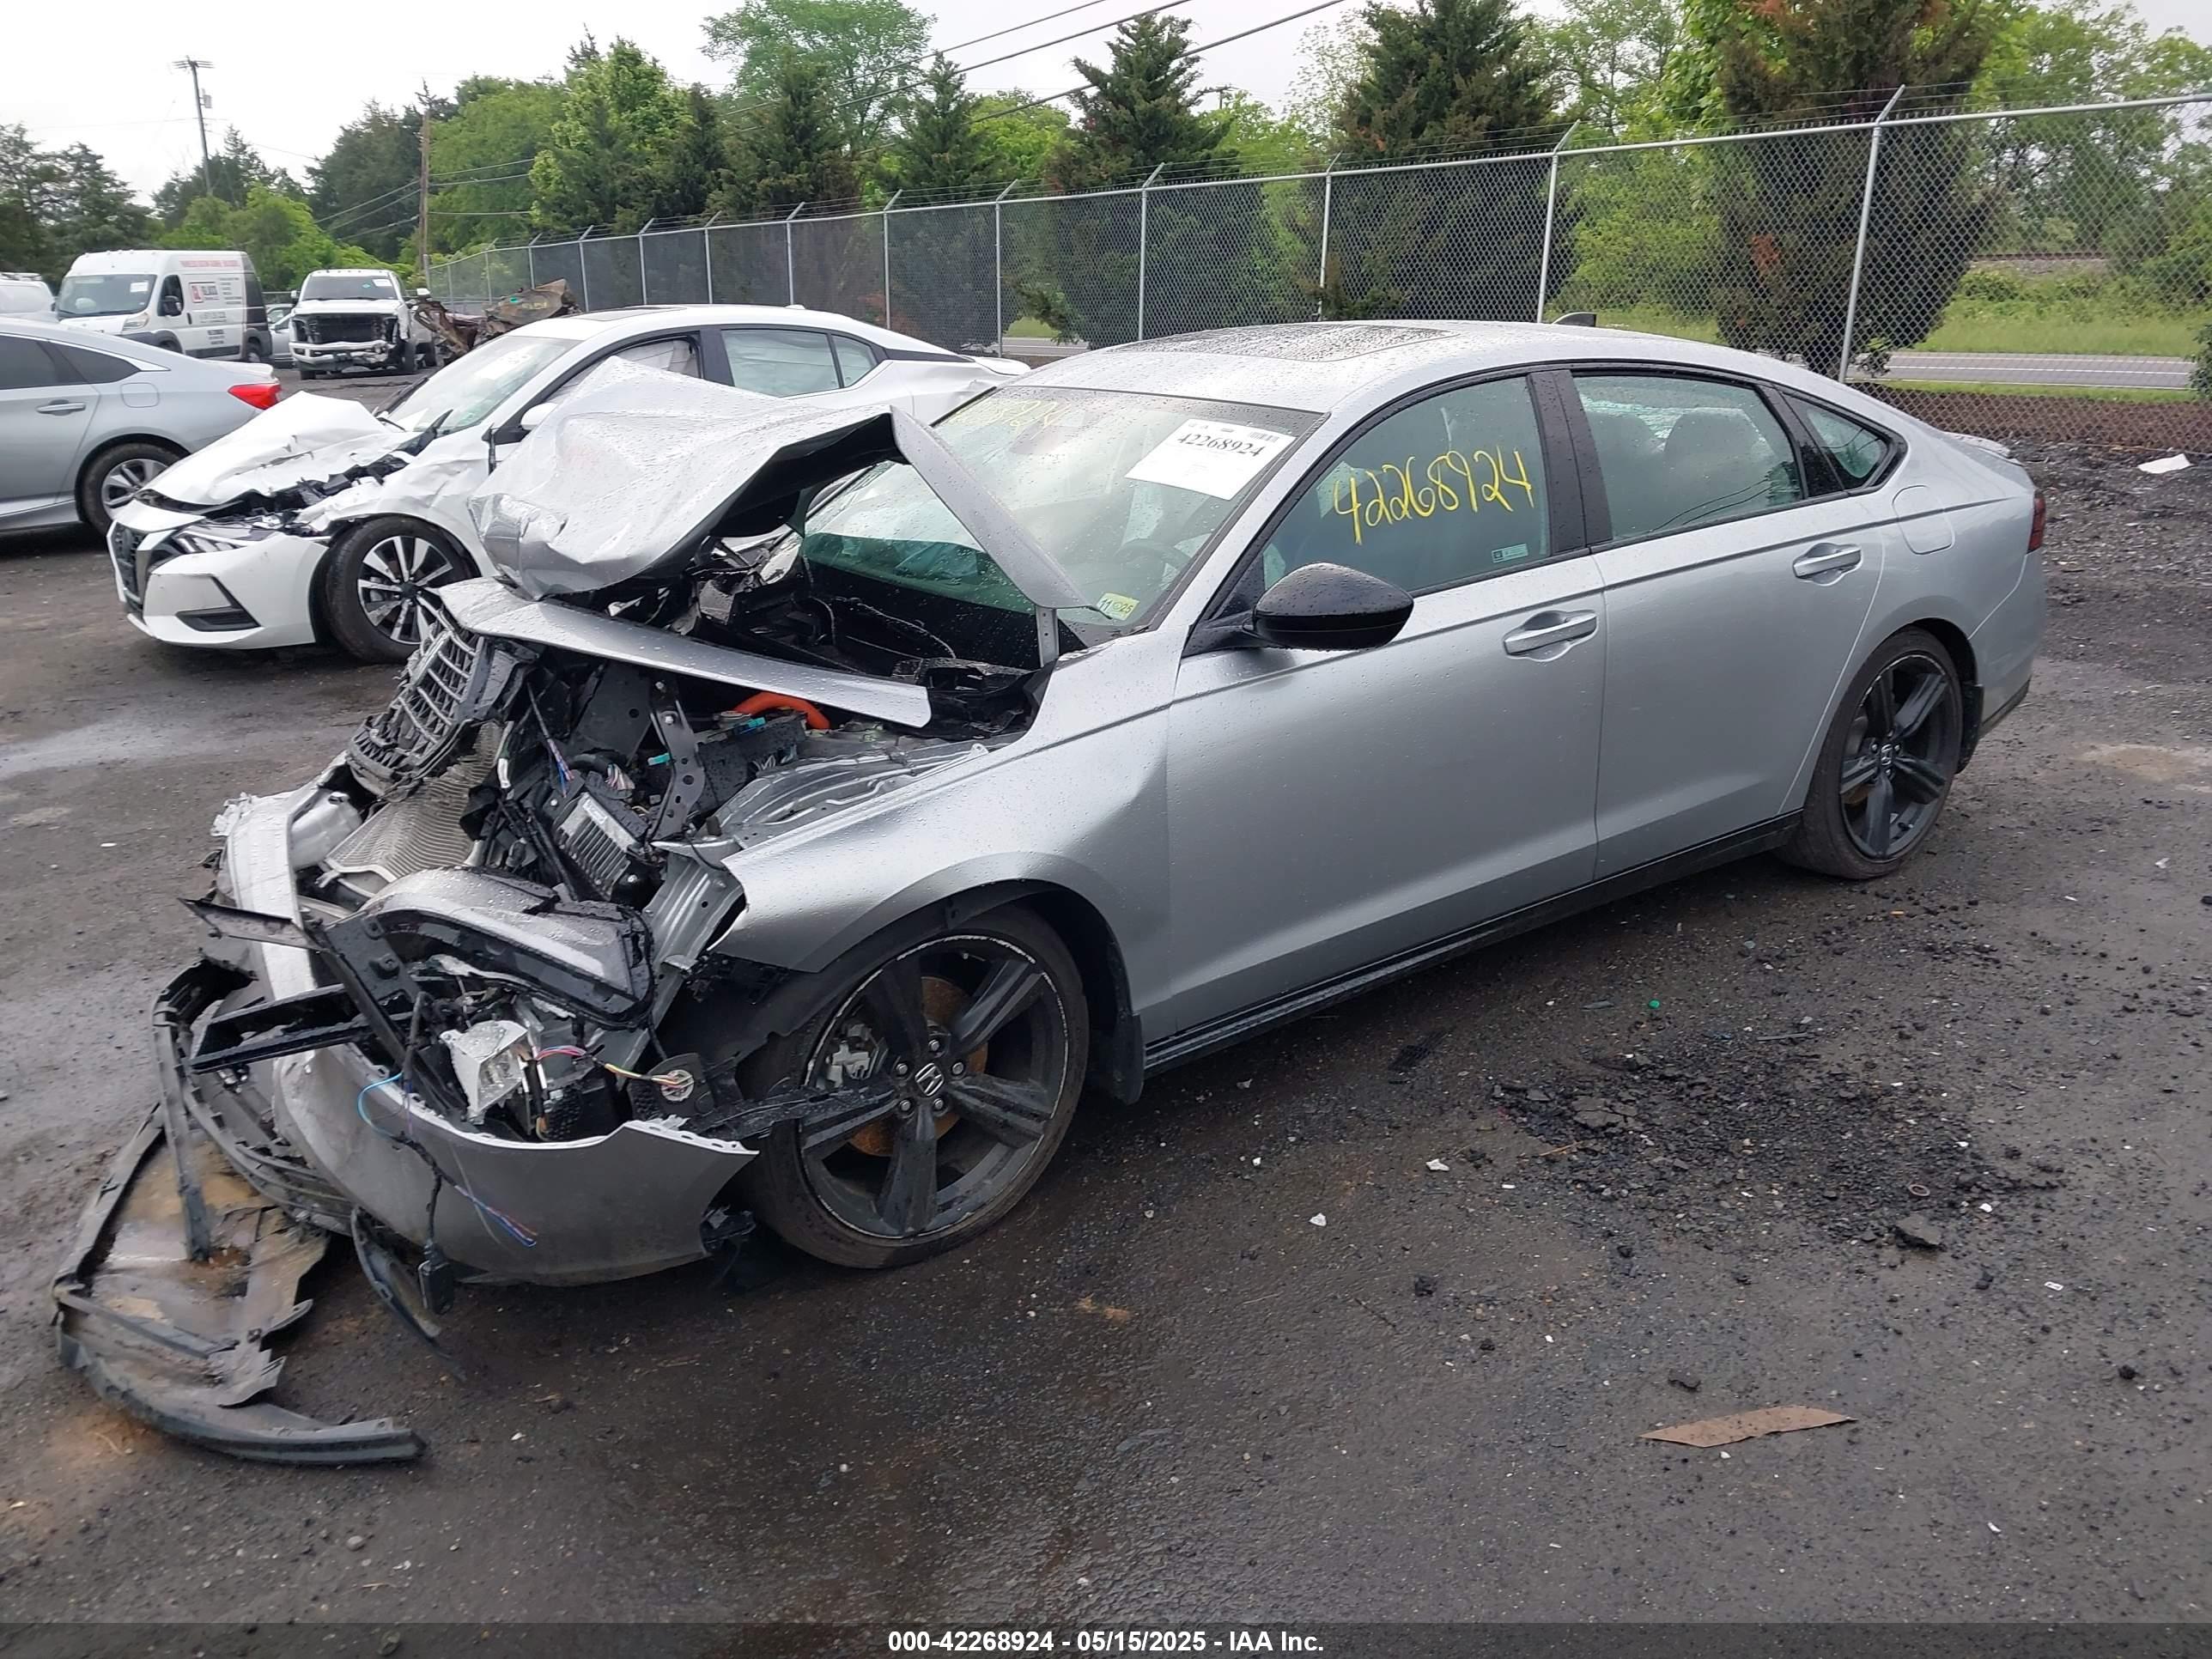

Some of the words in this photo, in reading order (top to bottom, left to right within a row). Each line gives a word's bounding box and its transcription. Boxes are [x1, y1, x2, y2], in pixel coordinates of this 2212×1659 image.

[1177, 433, 1267, 457] 42268924
[1333, 446, 1535, 545] 42268924
[1118, 603, 1133, 613] 25
